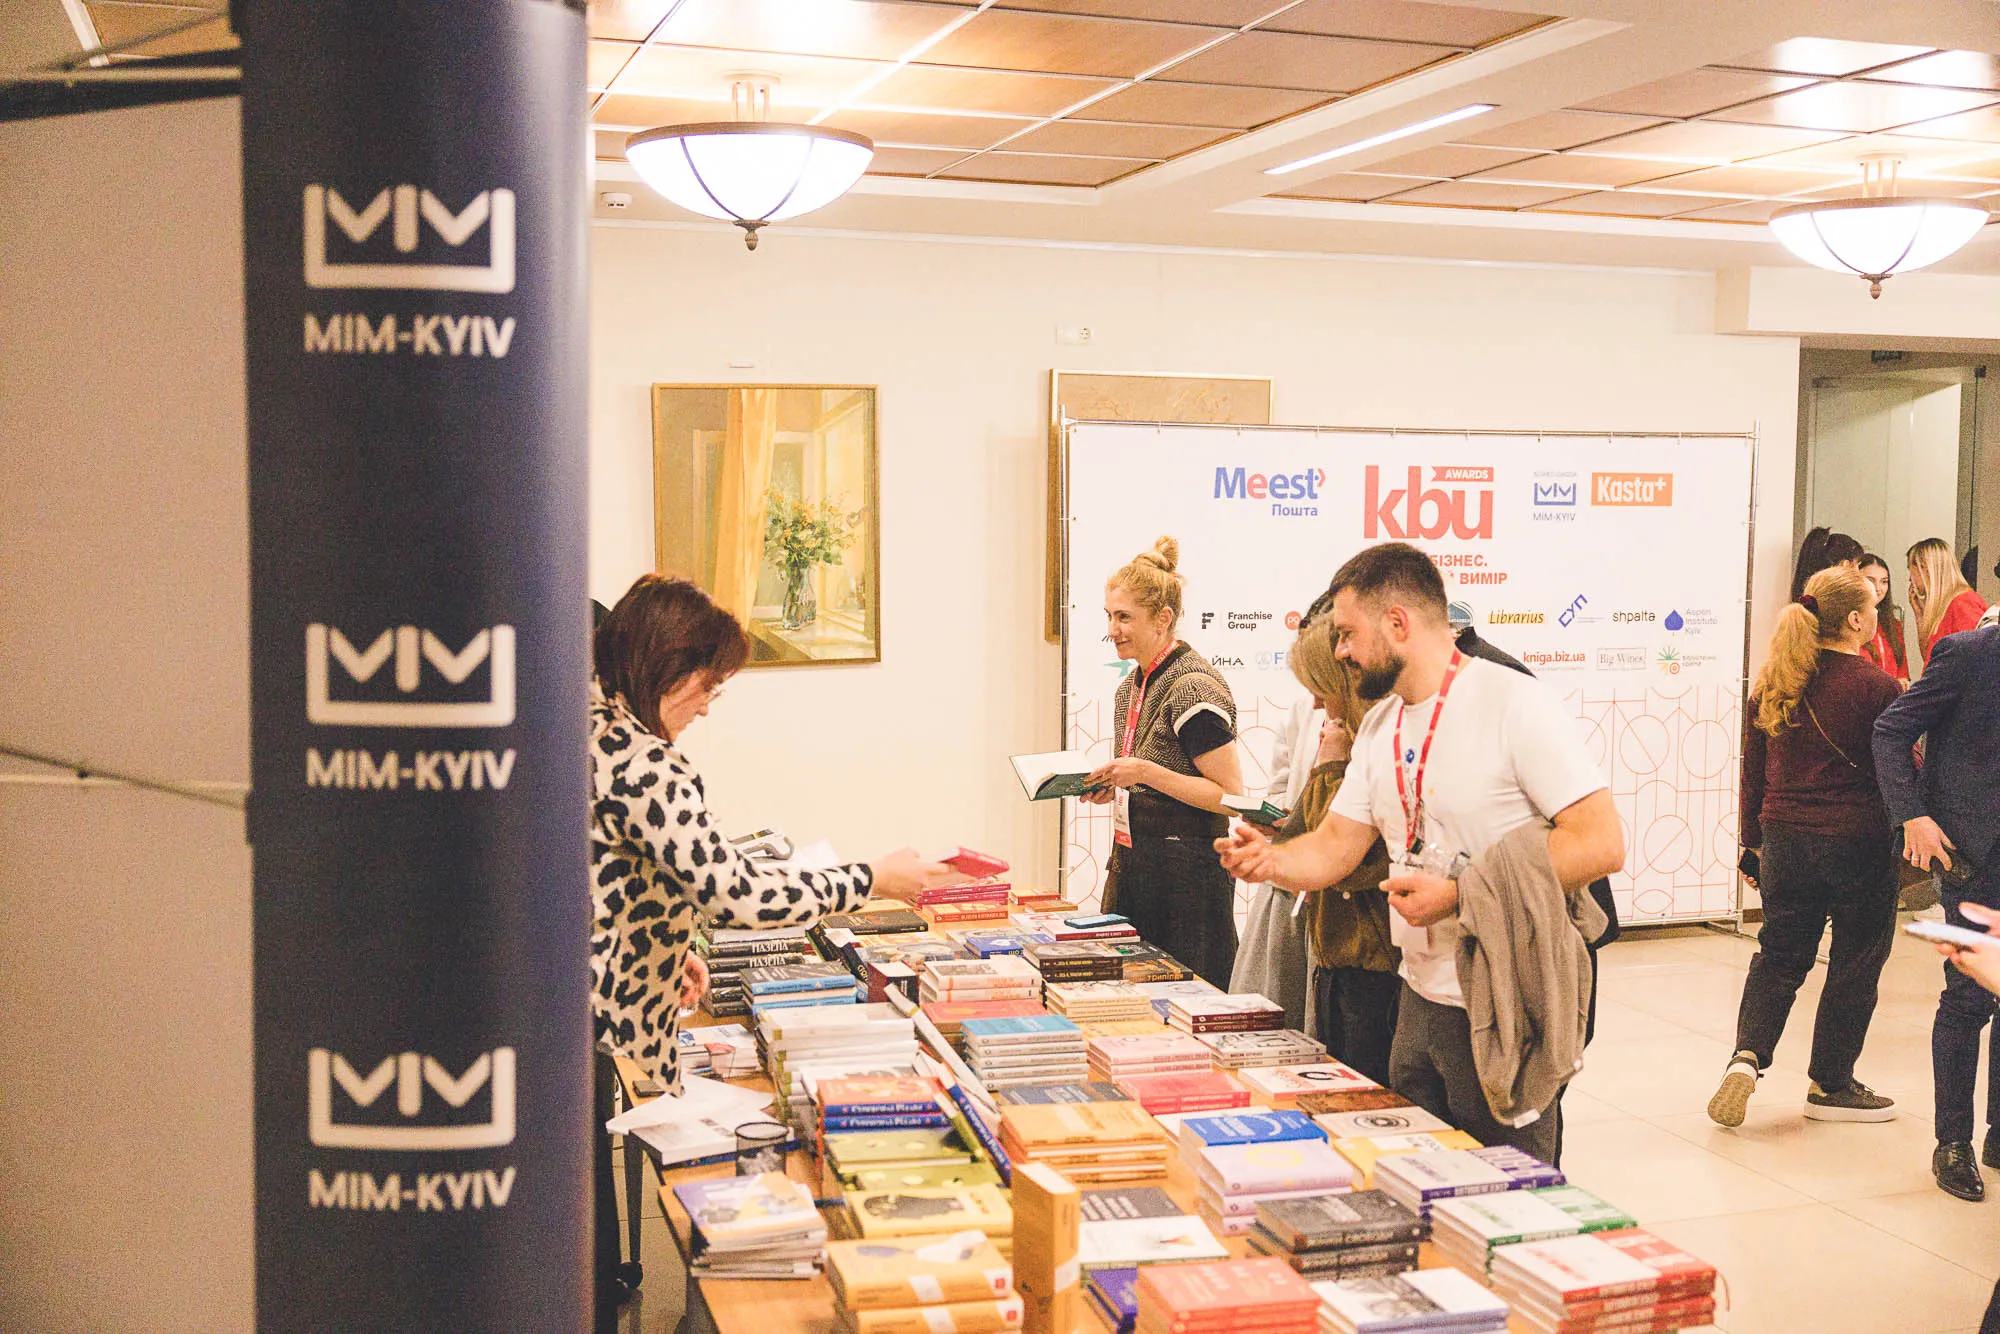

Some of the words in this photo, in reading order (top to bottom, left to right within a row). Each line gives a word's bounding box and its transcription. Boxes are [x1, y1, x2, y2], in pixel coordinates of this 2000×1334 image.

[303, 312, 516, 358] MIM-KYIV
[1444, 468, 1489, 480] AWARDS
[1213, 466, 1319, 500] Meest
[1271, 503, 1319, 517] Пошта
[1363, 464, 1495, 541] kbu
[1532, 511, 1576, 522] MIM-KYIV
[1459, 572, 1508, 585] ВИМІР
[1227, 610, 1273, 621] Franchise
[1489, 609, 1545, 625] Librarius
[1612, 610, 1656, 624] shpalta
[1227, 621, 1258, 632] Group
[1523, 650, 1586, 666] kniga.biz.ua
[306, 748, 517, 791] MIM-KYIV
[308, 1166, 516, 1211] MIM-KYIV
